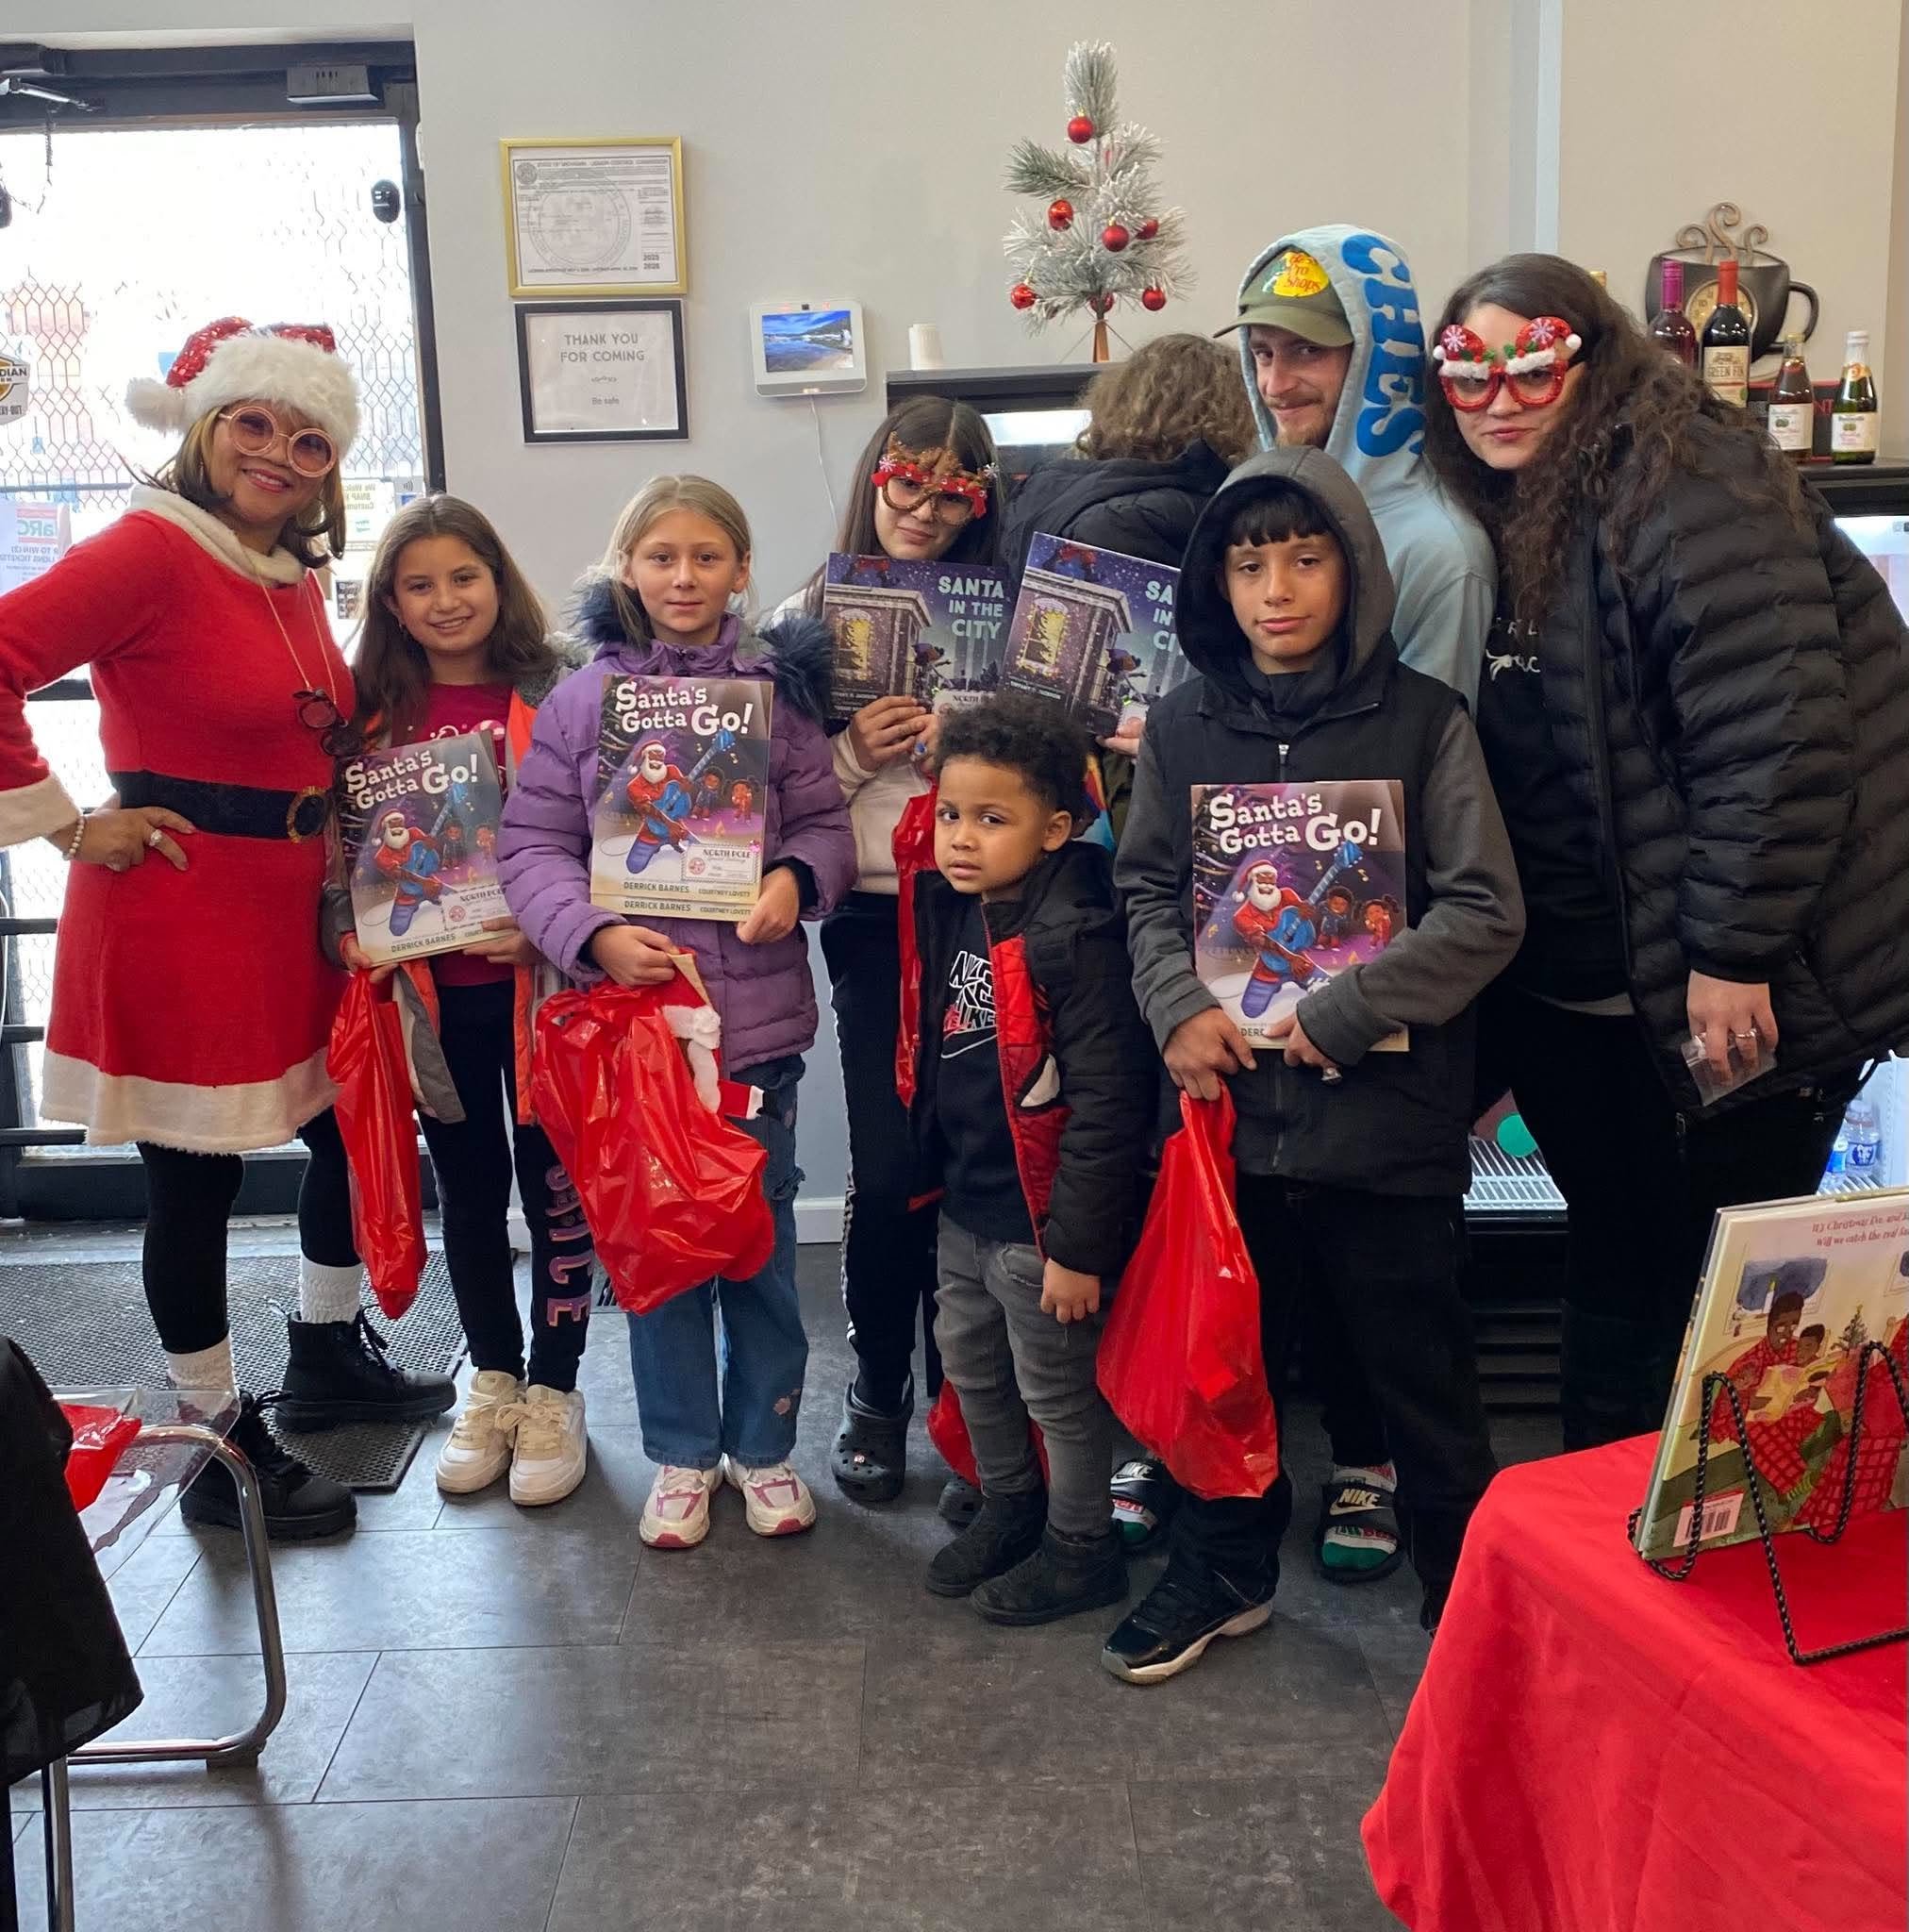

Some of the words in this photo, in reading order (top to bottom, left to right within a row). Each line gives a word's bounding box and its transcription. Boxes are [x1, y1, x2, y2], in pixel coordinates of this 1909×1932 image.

[564, 333, 607, 346] THANK
[611, 332, 639, 344] YOU
[560, 351, 588, 362] FOR
[592, 349, 645, 362] COMING
[938, 575, 1004, 599] SANTA
[949, 599, 966, 614] IN
[971, 601, 1004, 618] THE
[1153, 608, 1173, 625] IN
[952, 618, 1002, 640] CITY
[616, 682, 708, 711] Santa's
[622, 711, 687, 733] Gotta
[690, 703, 754, 736] Go!
[345, 750, 433, 793] Santa's
[357, 777, 420, 809] Gotta
[422, 754, 478, 794] Go!
[1209, 792, 1322, 831] Santa's
[1220, 824, 1301, 854] Gotta
[1305, 808, 1382, 851] Go!
[623, 881, 657, 891] DERRICK
[659, 884, 689, 893] BARNES
[623, 900, 658, 910] DERRICK
[659, 903, 691, 912] BARNES
[390, 940, 423, 953] DERRICK
[424, 932, 456, 945] BARNES
[1338, 1488, 1382, 1507] NIKE
